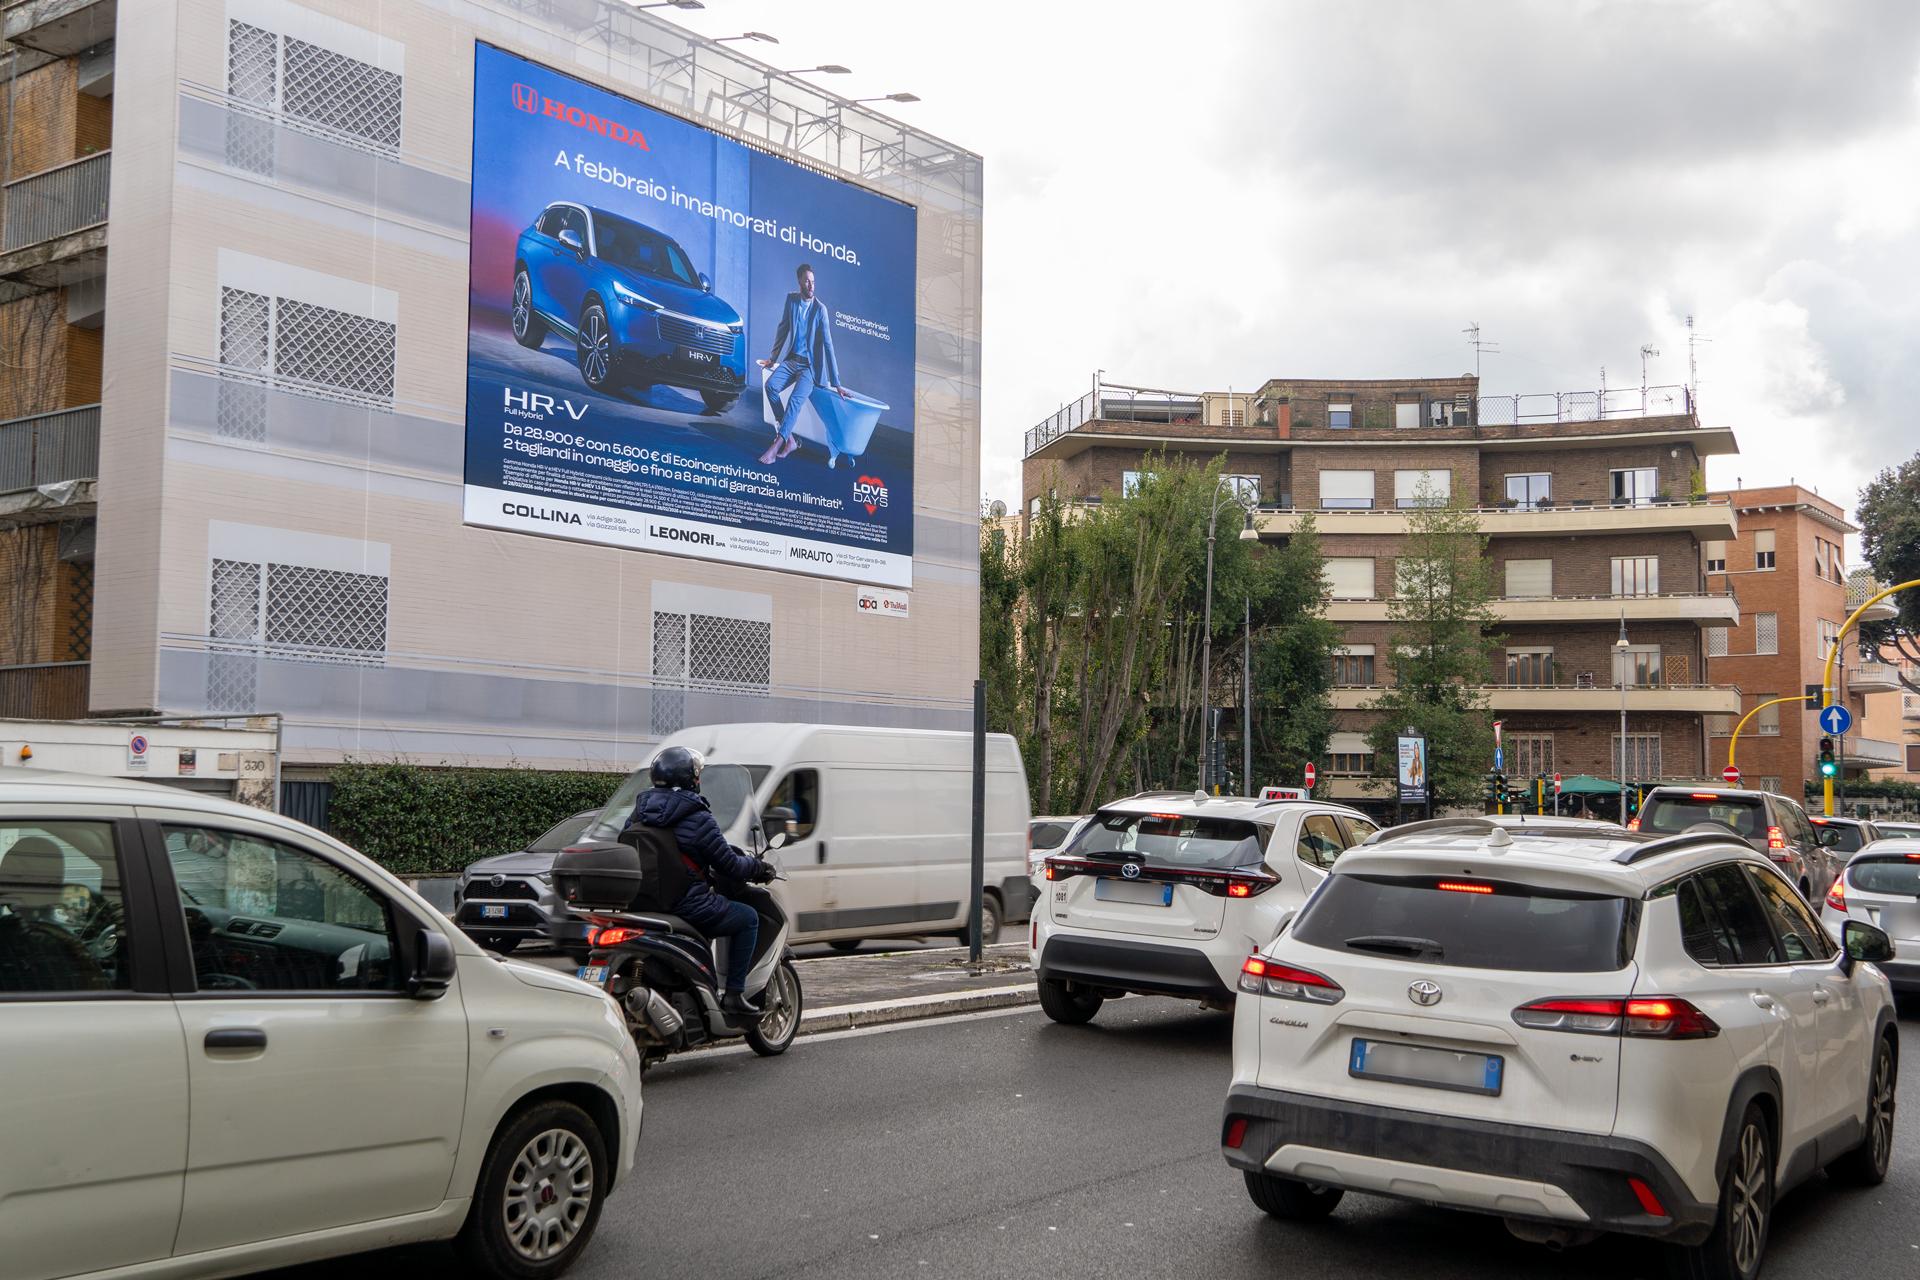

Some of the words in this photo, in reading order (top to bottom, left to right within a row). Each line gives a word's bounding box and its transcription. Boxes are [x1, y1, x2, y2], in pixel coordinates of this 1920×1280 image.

[541, 96, 649, 151] HONDA
[555, 145, 570, 169] A
[574, 152, 666, 201] febbraio
[671, 185, 776, 238] innamorati
[780, 222, 795, 244] di
[800, 229, 860, 266] Honda.
[835, 310, 861, 323] Gregorio
[862, 318, 888, 331] Paltrinieri
[835, 318, 866, 333] Campione
[866, 327, 871, 335] di
[872, 329, 890, 340] Nuoto
[503, 406, 517, 415] Full
[518, 409, 543, 420] Hybrid
[504, 387, 588, 422] HR-V
[503, 421, 521, 436] Da
[524, 425, 573, 446] 28.900
[574, 434, 584, 448] €
[586, 440, 610, 453] con
[612, 442, 648, 460] 5.600
[650, 449, 659, 462] €
[661, 451, 671, 464] di
[673, 454, 740, 477] Ecoincentivi
[742, 467, 779, 486] Honda,
[503, 436, 512, 449] 2
[514, 438, 570, 459] tagliandi
[572, 449, 583, 462] in
[585, 454, 638, 473] omaggio
[640, 465, 648, 474] e
[649, 463, 672, 478] fino
[674, 471, 681, 480] a
[683, 470, 691, 481] 8
[693, 474, 716, 486] anni
[718, 476, 727, 488] di
[729, 481, 774, 497] garanzia
[776, 490, 783, 498] a
[784, 489, 800, 501] km
[853, 482, 888, 497] LOVE
[853, 492, 888, 507] DAYS
[502, 502, 582, 525] COLLINA
[596, 515, 612, 523] Adige
[596, 522, 617, 530] Gozzoli
[649, 524, 714, 545] LEONORI
[790, 546, 832, 563] MIRAUTO
[244, 760, 265, 771] 330
[1267, 791, 1297, 800] TAXI
